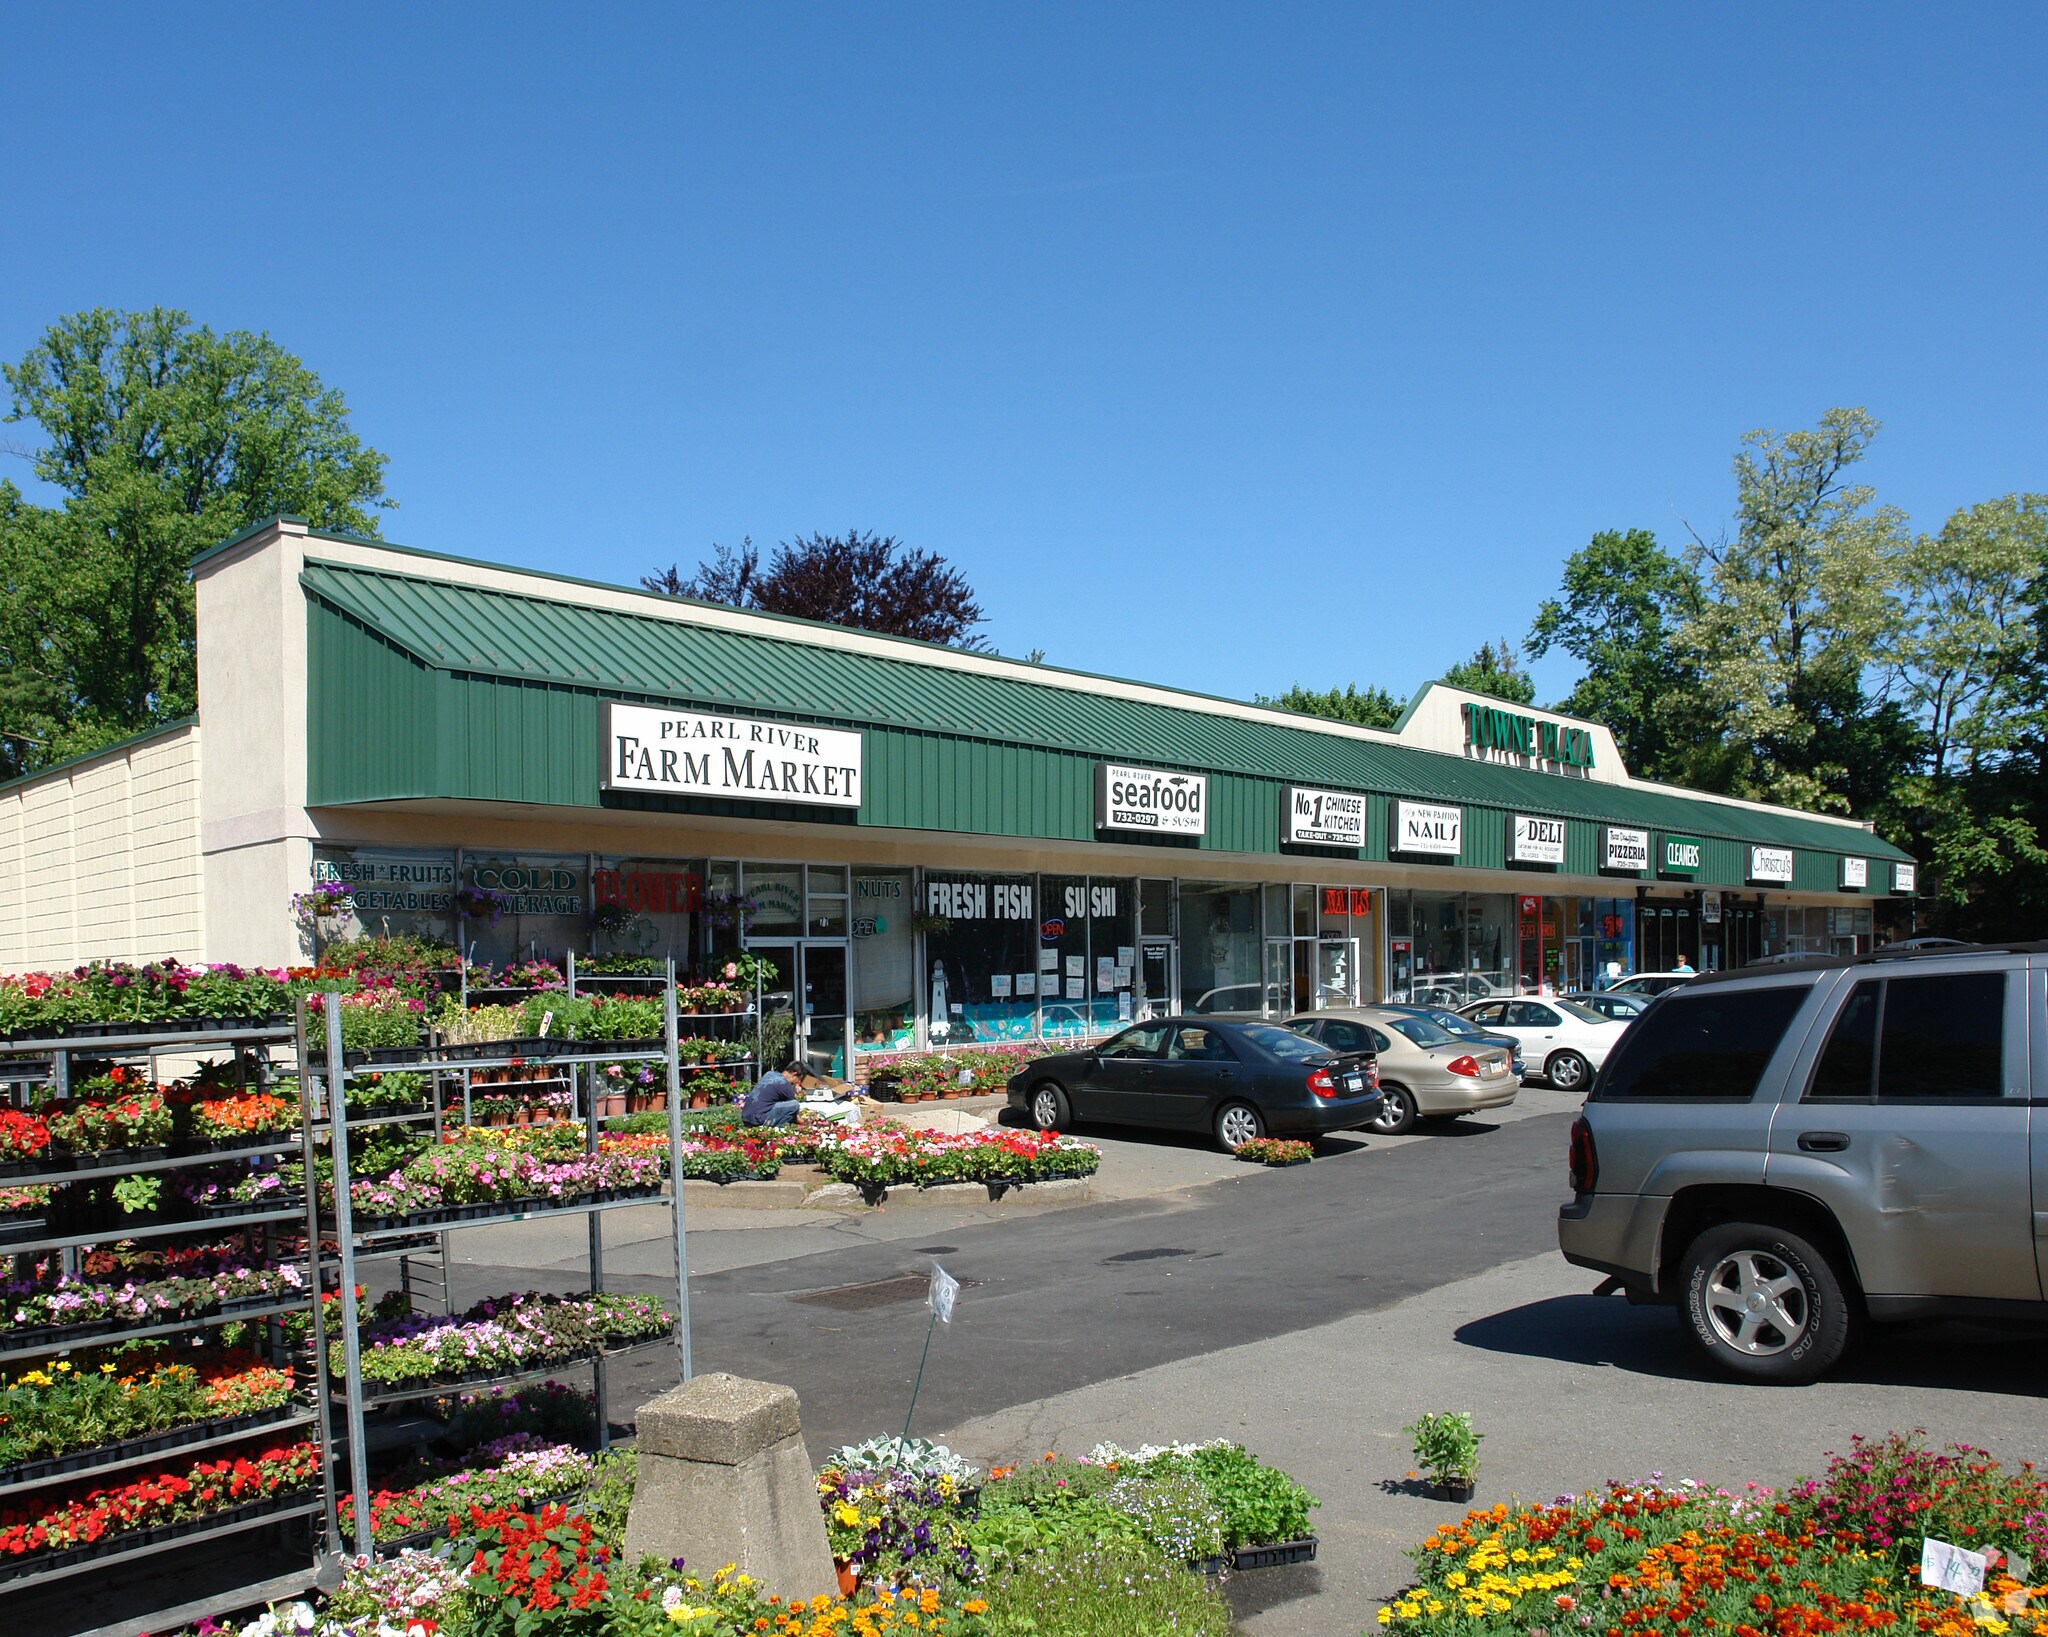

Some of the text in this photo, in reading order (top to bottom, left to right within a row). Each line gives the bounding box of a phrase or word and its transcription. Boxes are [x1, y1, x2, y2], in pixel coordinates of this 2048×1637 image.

[660, 720, 820, 755] PEARL RIVER
[1462, 703, 1596, 769] TOWNE PLAZA
[616, 736, 857, 797] FARM MARKET
[1112, 769, 1152, 781] PEARL RIVER
[1112, 778, 1200, 813] seafood
[1325, 796, 1362, 814] CHINESE
[1116, 812, 1156, 825] 732-0297
[1172, 816, 1200, 828] SUSHI
[1323, 814, 1361, 832] KITCHEN
[1418, 809, 1432, 818] NEW
[1408, 820, 1458, 841] NAILS
[1527, 820, 1562, 843] DELI
[1609, 844, 1645, 860] PIZZERIA
[1667, 842, 1700, 867] CLEANERS
[315, 861, 453, 884] FRESH FRUITS
[474, 867, 577, 892] COLD
[857, 879, 901, 898] NUTS
[343, 890, 451, 912] EGETABLES
[502, 894, 581, 915] VERAGE
[928, 882, 987, 919] FRESH
[993, 884, 1032, 920] FISH
[1323, 889, 1369, 917] NAILS
[1040, 923, 1065, 937] OPEN
